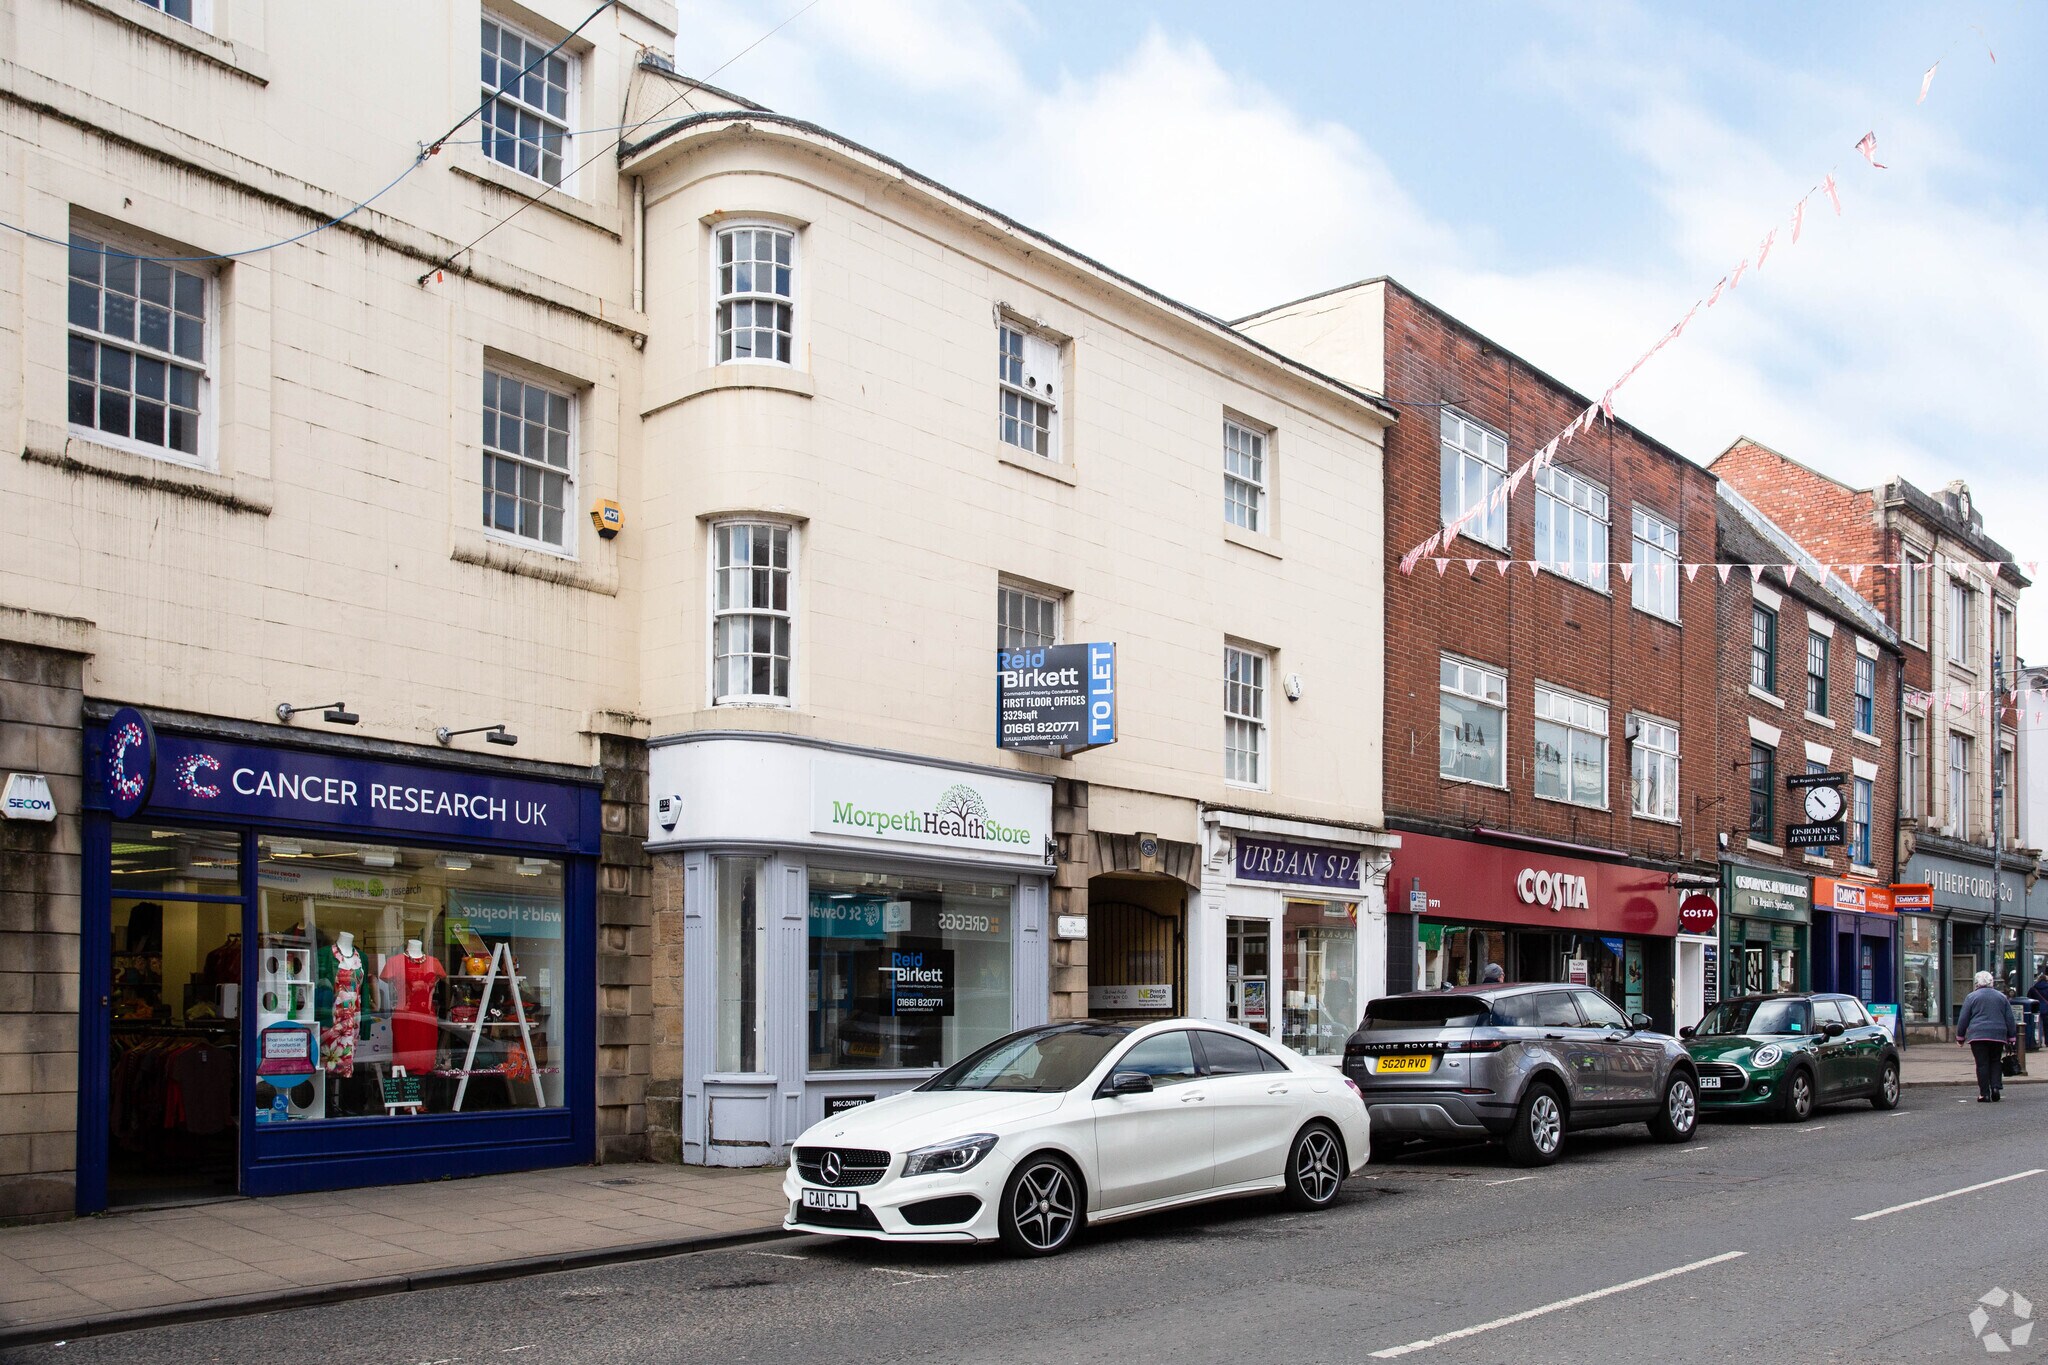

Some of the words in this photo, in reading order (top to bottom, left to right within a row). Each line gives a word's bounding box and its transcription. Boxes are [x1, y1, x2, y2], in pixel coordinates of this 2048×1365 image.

[605, 510, 618, 520] ADT
[998, 649, 1045, 669] Reid
[1003, 668, 1079, 688] Birkett
[1092, 648, 1112, 695] LET
[1003, 698, 1024, 708] FIRST
[1026, 697, 1052, 707] FLOOR
[1054, 696, 1086, 706] OFFICES
[1003, 710, 1038, 721] 3329sqft
[1092, 701, 1110, 736] TO
[1004, 723, 1035, 734] 01661
[1037, 722, 1079, 733] 820771
[9, 798, 50, 810] SECOM
[232, 768, 358, 806] CANCER
[370, 784, 506, 822] RESEARCH
[516, 800, 546, 826] UK
[1792, 827, 1838, 835] OSBORNES
[1244, 845, 1318, 876] URBAN
[1324, 855, 1360, 881] SPA
[391, 884, 422, 896] research
[1518, 868, 1589, 912] COSTA
[1736, 876, 1770, 892] OSBORNES
[1772, 881, 1807, 898] JEWELLERS
[1925, 869, 1992, 898] RUTHERFORD
[2000, 882, 2012, 902] Co
[1429, 899, 1440, 908] 1971
[1750, 896, 1758, 906] The
[1839, 888, 1865, 905] DAWSON
[1683, 910, 1714, 918] COSTA
[892, 952, 922, 966] Reid
[896, 967, 943, 982] Birkett
[1382, 1059, 1406, 1068] SG20
[1408, 1058, 1426, 1068] RVO
[828, 1194, 848, 1208] CLJ
